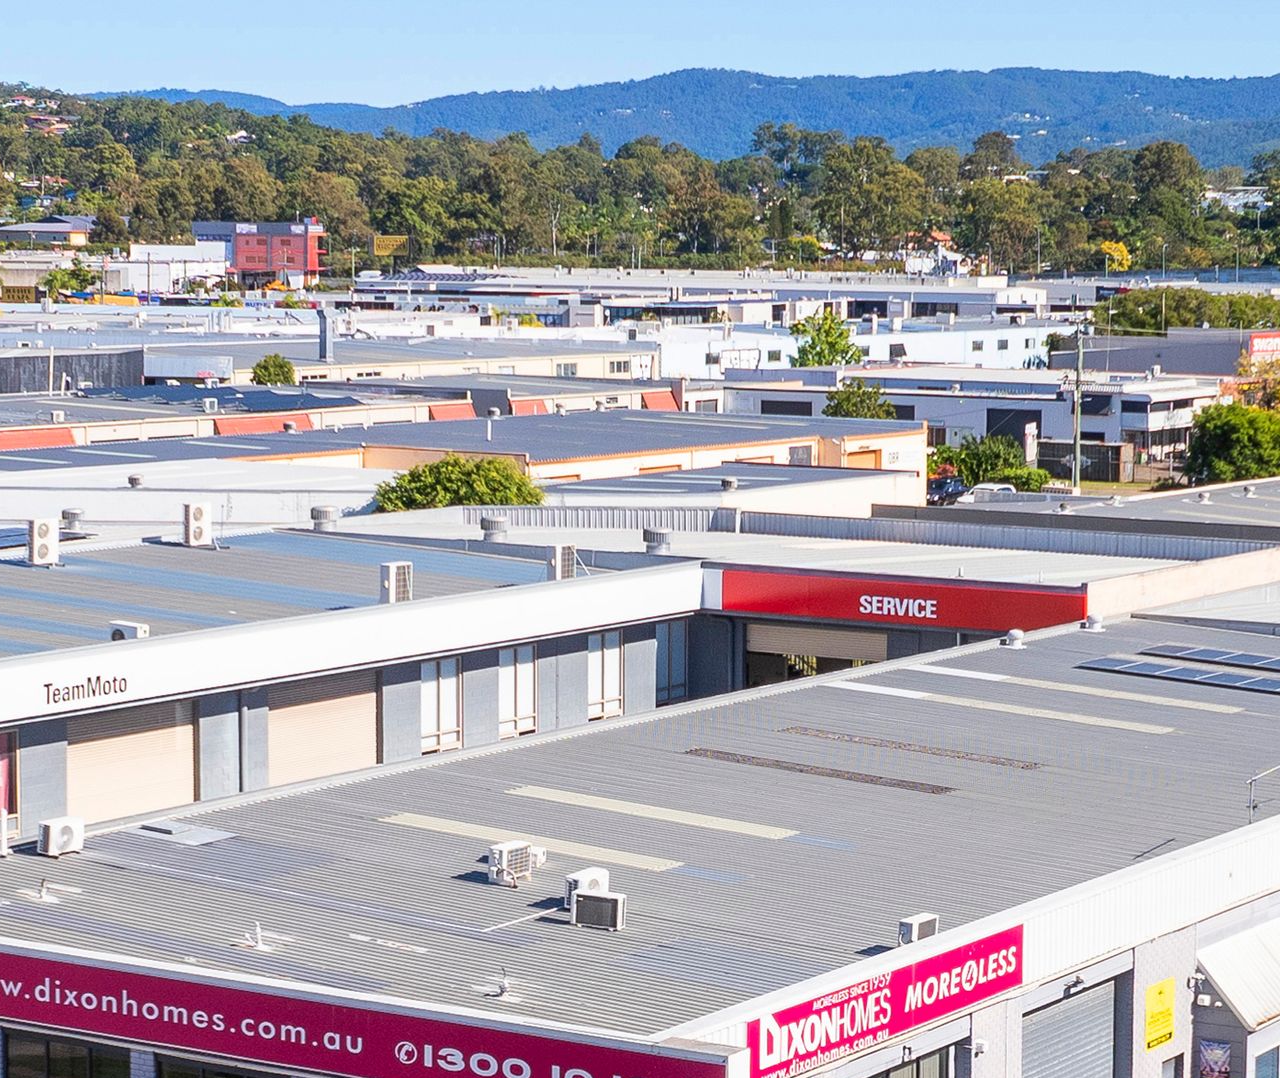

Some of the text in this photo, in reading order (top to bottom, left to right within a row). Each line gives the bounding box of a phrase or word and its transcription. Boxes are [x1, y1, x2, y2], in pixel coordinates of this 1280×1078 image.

[858, 594, 938, 619] SERVICE
[43, 674, 128, 705] TeamMoto
[850, 982, 870, 998] SINCE
[869, 970, 892, 992] 1959
